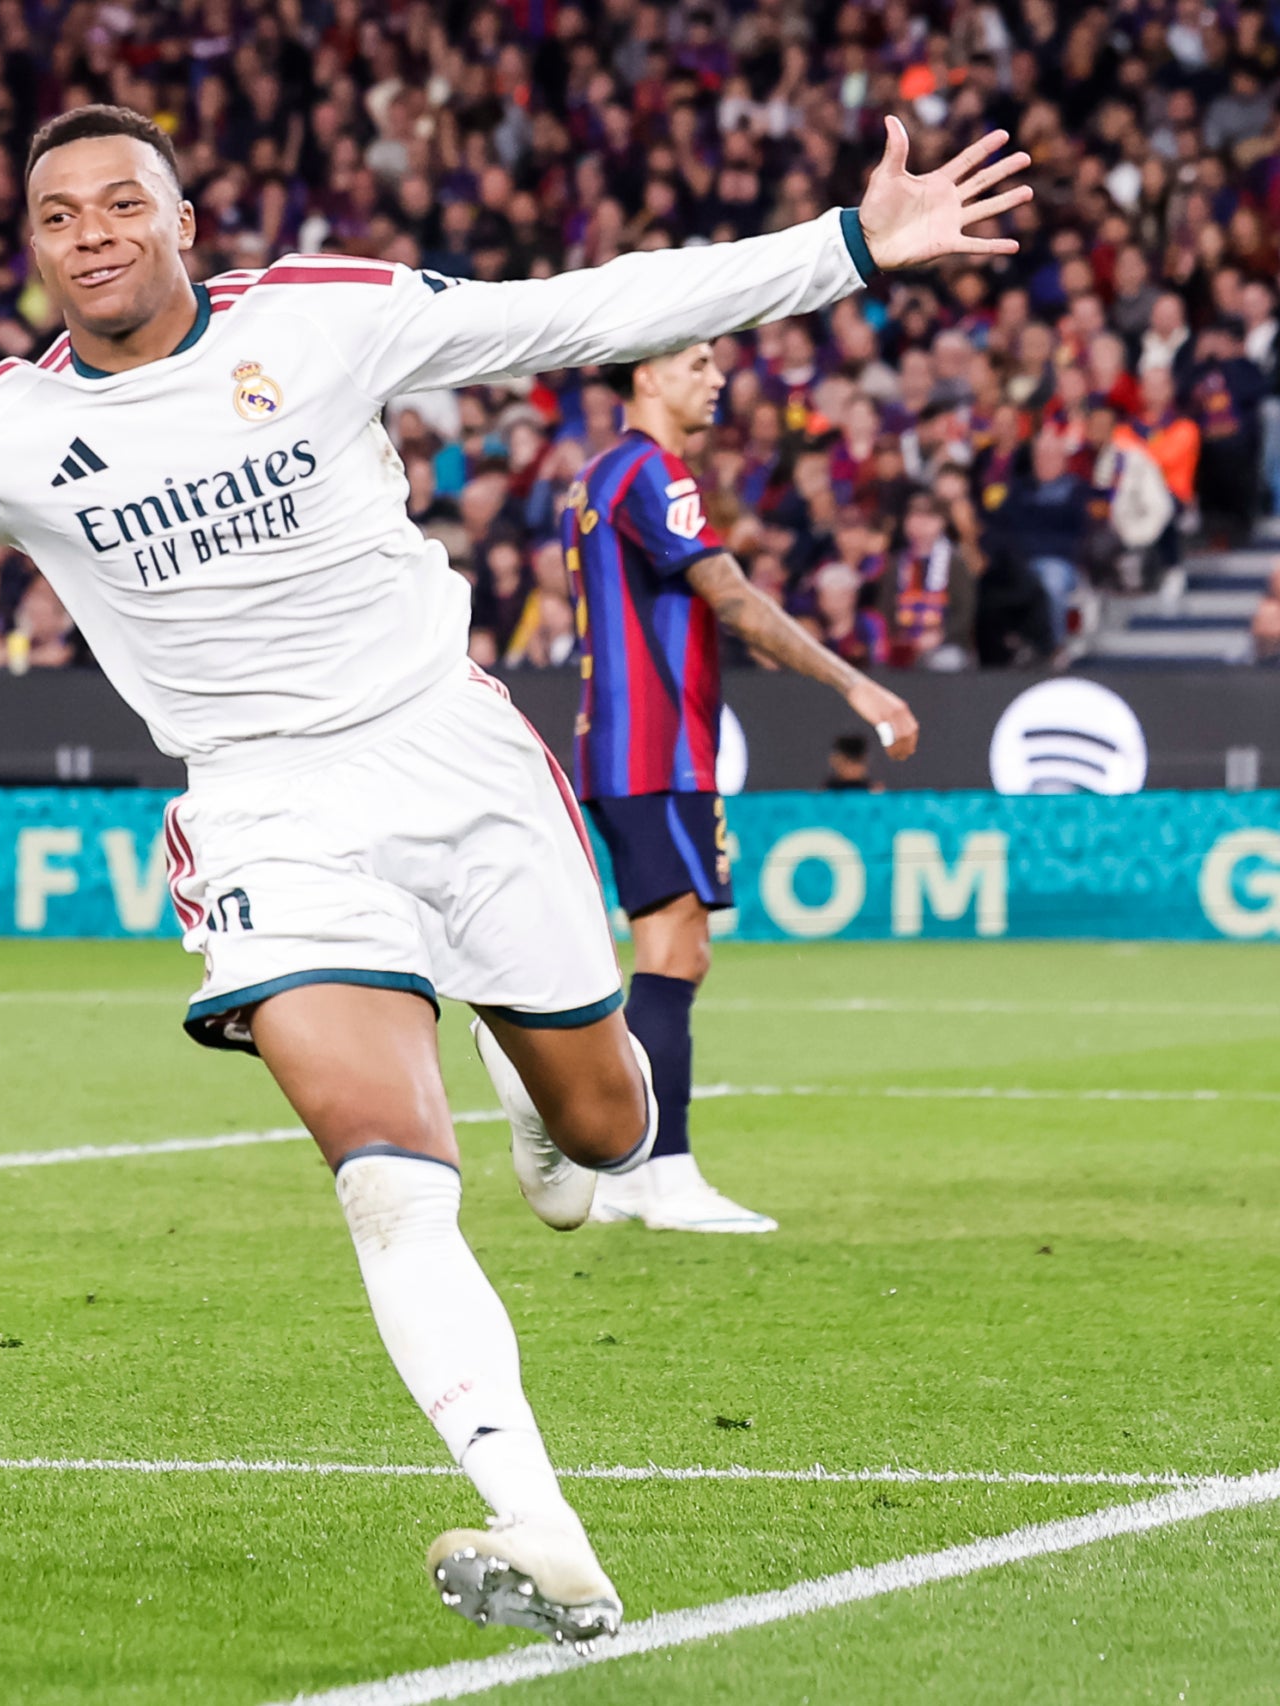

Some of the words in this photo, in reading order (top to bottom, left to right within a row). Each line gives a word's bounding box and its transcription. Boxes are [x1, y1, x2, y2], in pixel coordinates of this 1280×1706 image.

[75, 439, 317, 554] Emirates
[134, 537, 183, 587] FLY
[191, 493, 301, 565] BETTER
[613, 828, 1009, 937] OM
